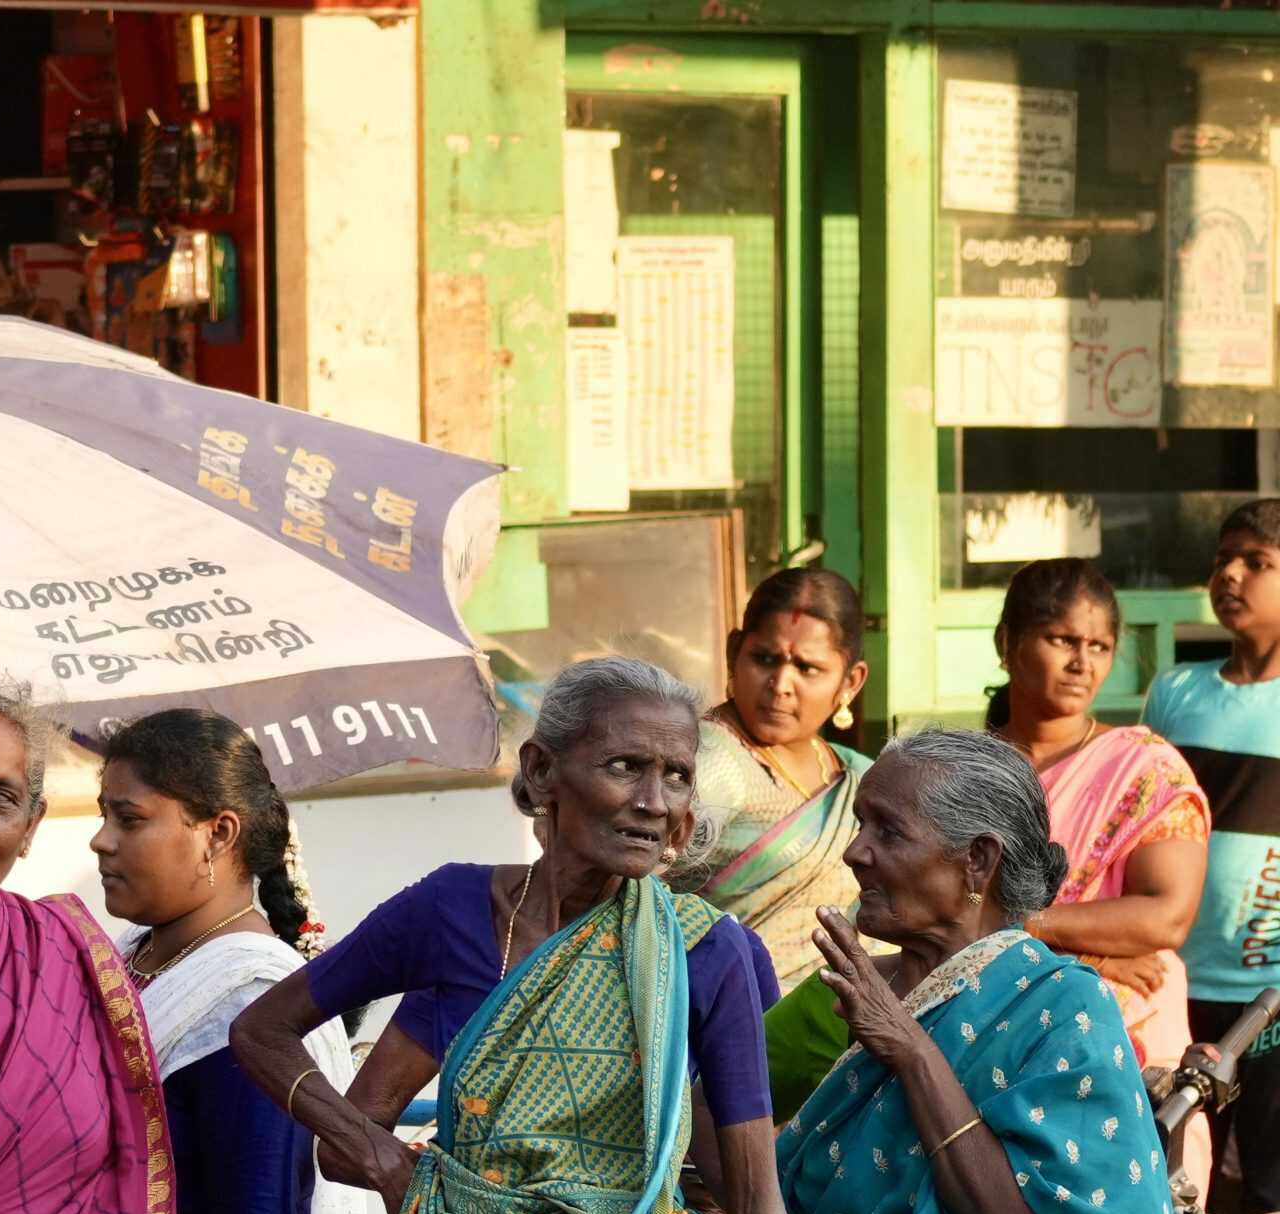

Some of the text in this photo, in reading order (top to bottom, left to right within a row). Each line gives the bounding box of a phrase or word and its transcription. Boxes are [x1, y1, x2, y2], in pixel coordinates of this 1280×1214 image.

[941, 342, 1154, 418] TNSTC
[35, 588, 252, 644] கட்டணம்
[332, 700, 439, 746] 9111
